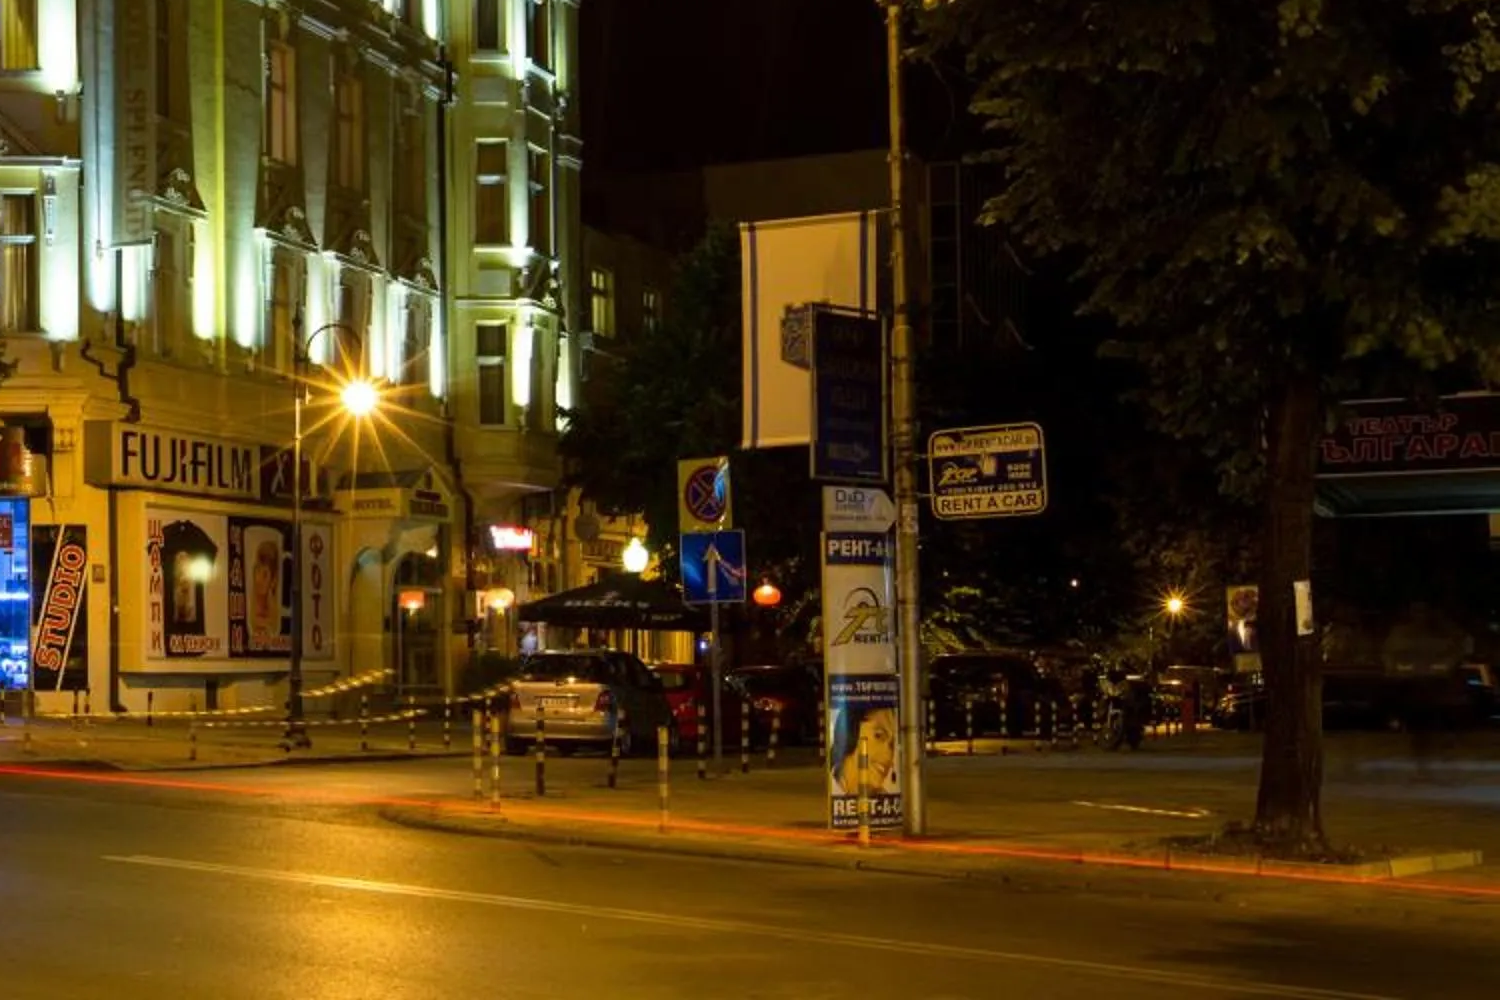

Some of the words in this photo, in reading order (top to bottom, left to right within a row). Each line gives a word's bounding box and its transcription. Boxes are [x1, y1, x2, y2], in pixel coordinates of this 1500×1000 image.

[122, 431, 250, 489] FUJIFILM
[1322, 431, 1500, 463] ЪЛГАРА
[941, 498, 982, 512] RENT
[988, 496, 998, 508] A
[1003, 494, 1038, 506] CAR
[35, 544, 86, 671] STUDIO
[309, 533, 324, 651] ФОТО
